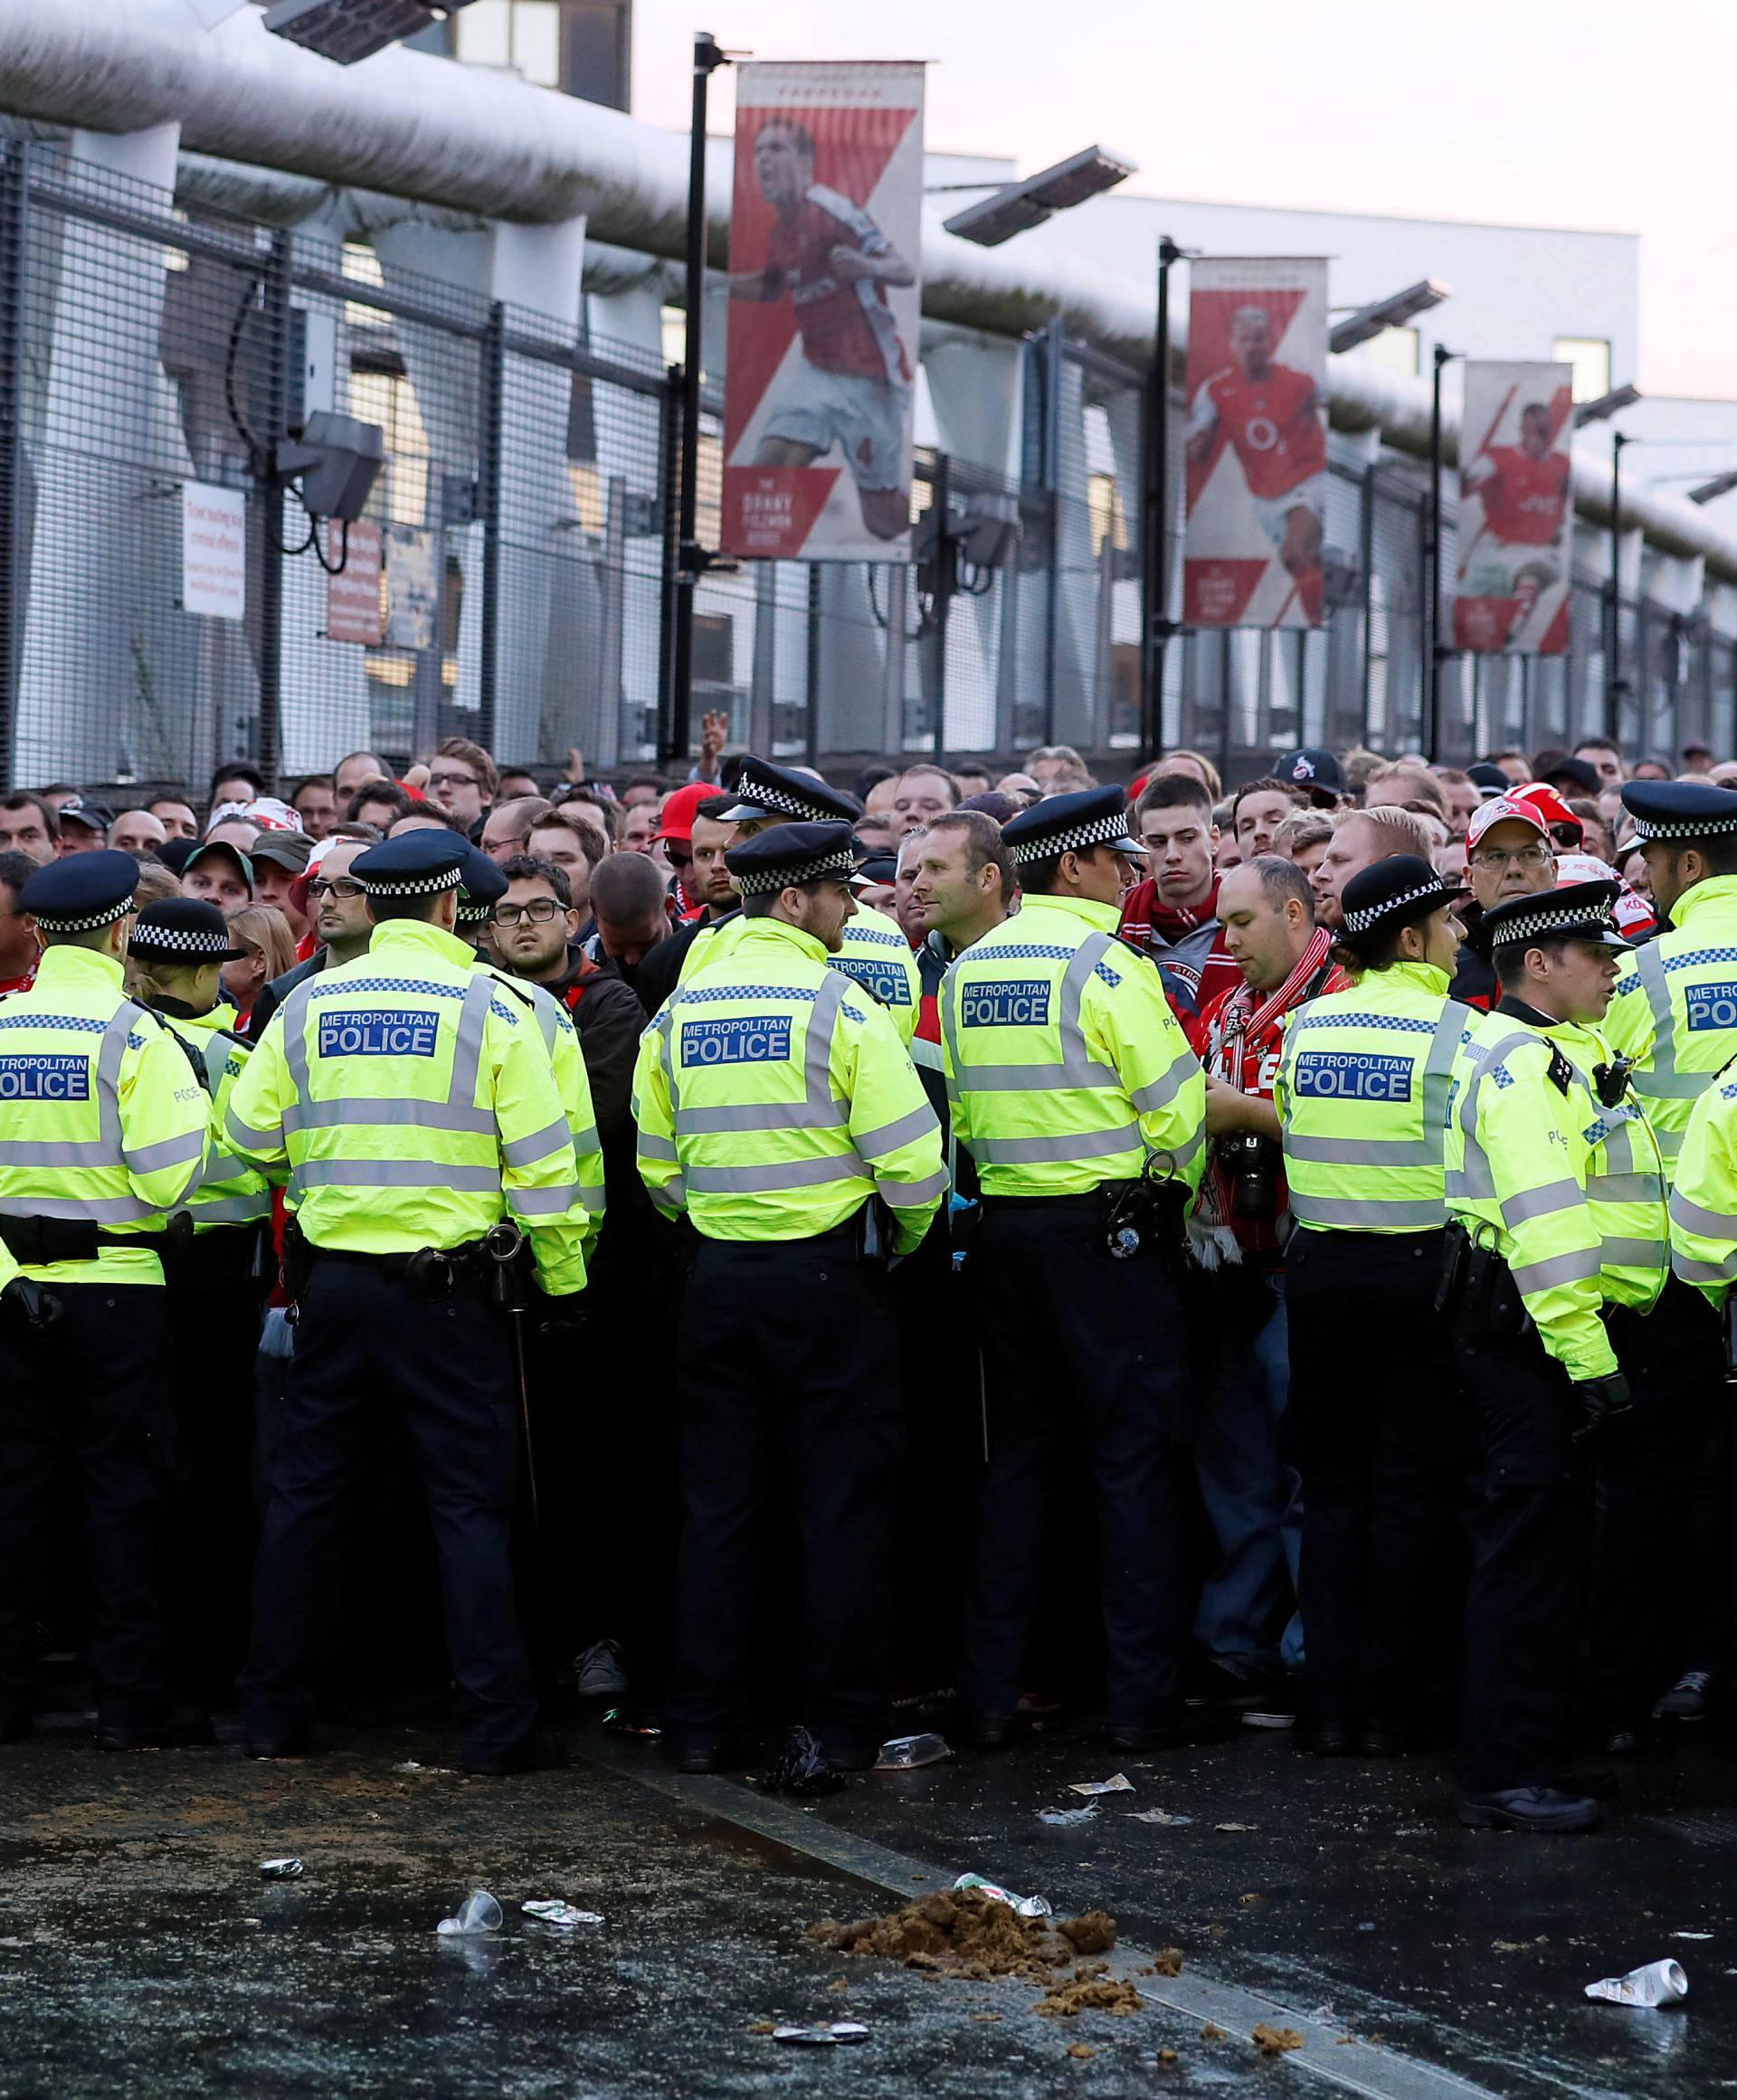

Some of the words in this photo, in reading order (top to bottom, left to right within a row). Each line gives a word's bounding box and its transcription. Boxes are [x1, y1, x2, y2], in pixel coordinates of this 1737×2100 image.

[963, 983, 1049, 998] METROPOLITAN
[321, 1013, 437, 1027] METROPOLITAN
[963, 998, 1047, 1024] POLICE
[683, 1019, 791, 1038] METROPOLITAN
[320, 1027, 434, 1054] POLICE
[683, 1032, 788, 1064] POLICE
[1297, 1054, 1412, 1072] METROPOLITAN
[1296, 1069, 1409, 1098] POLICE
